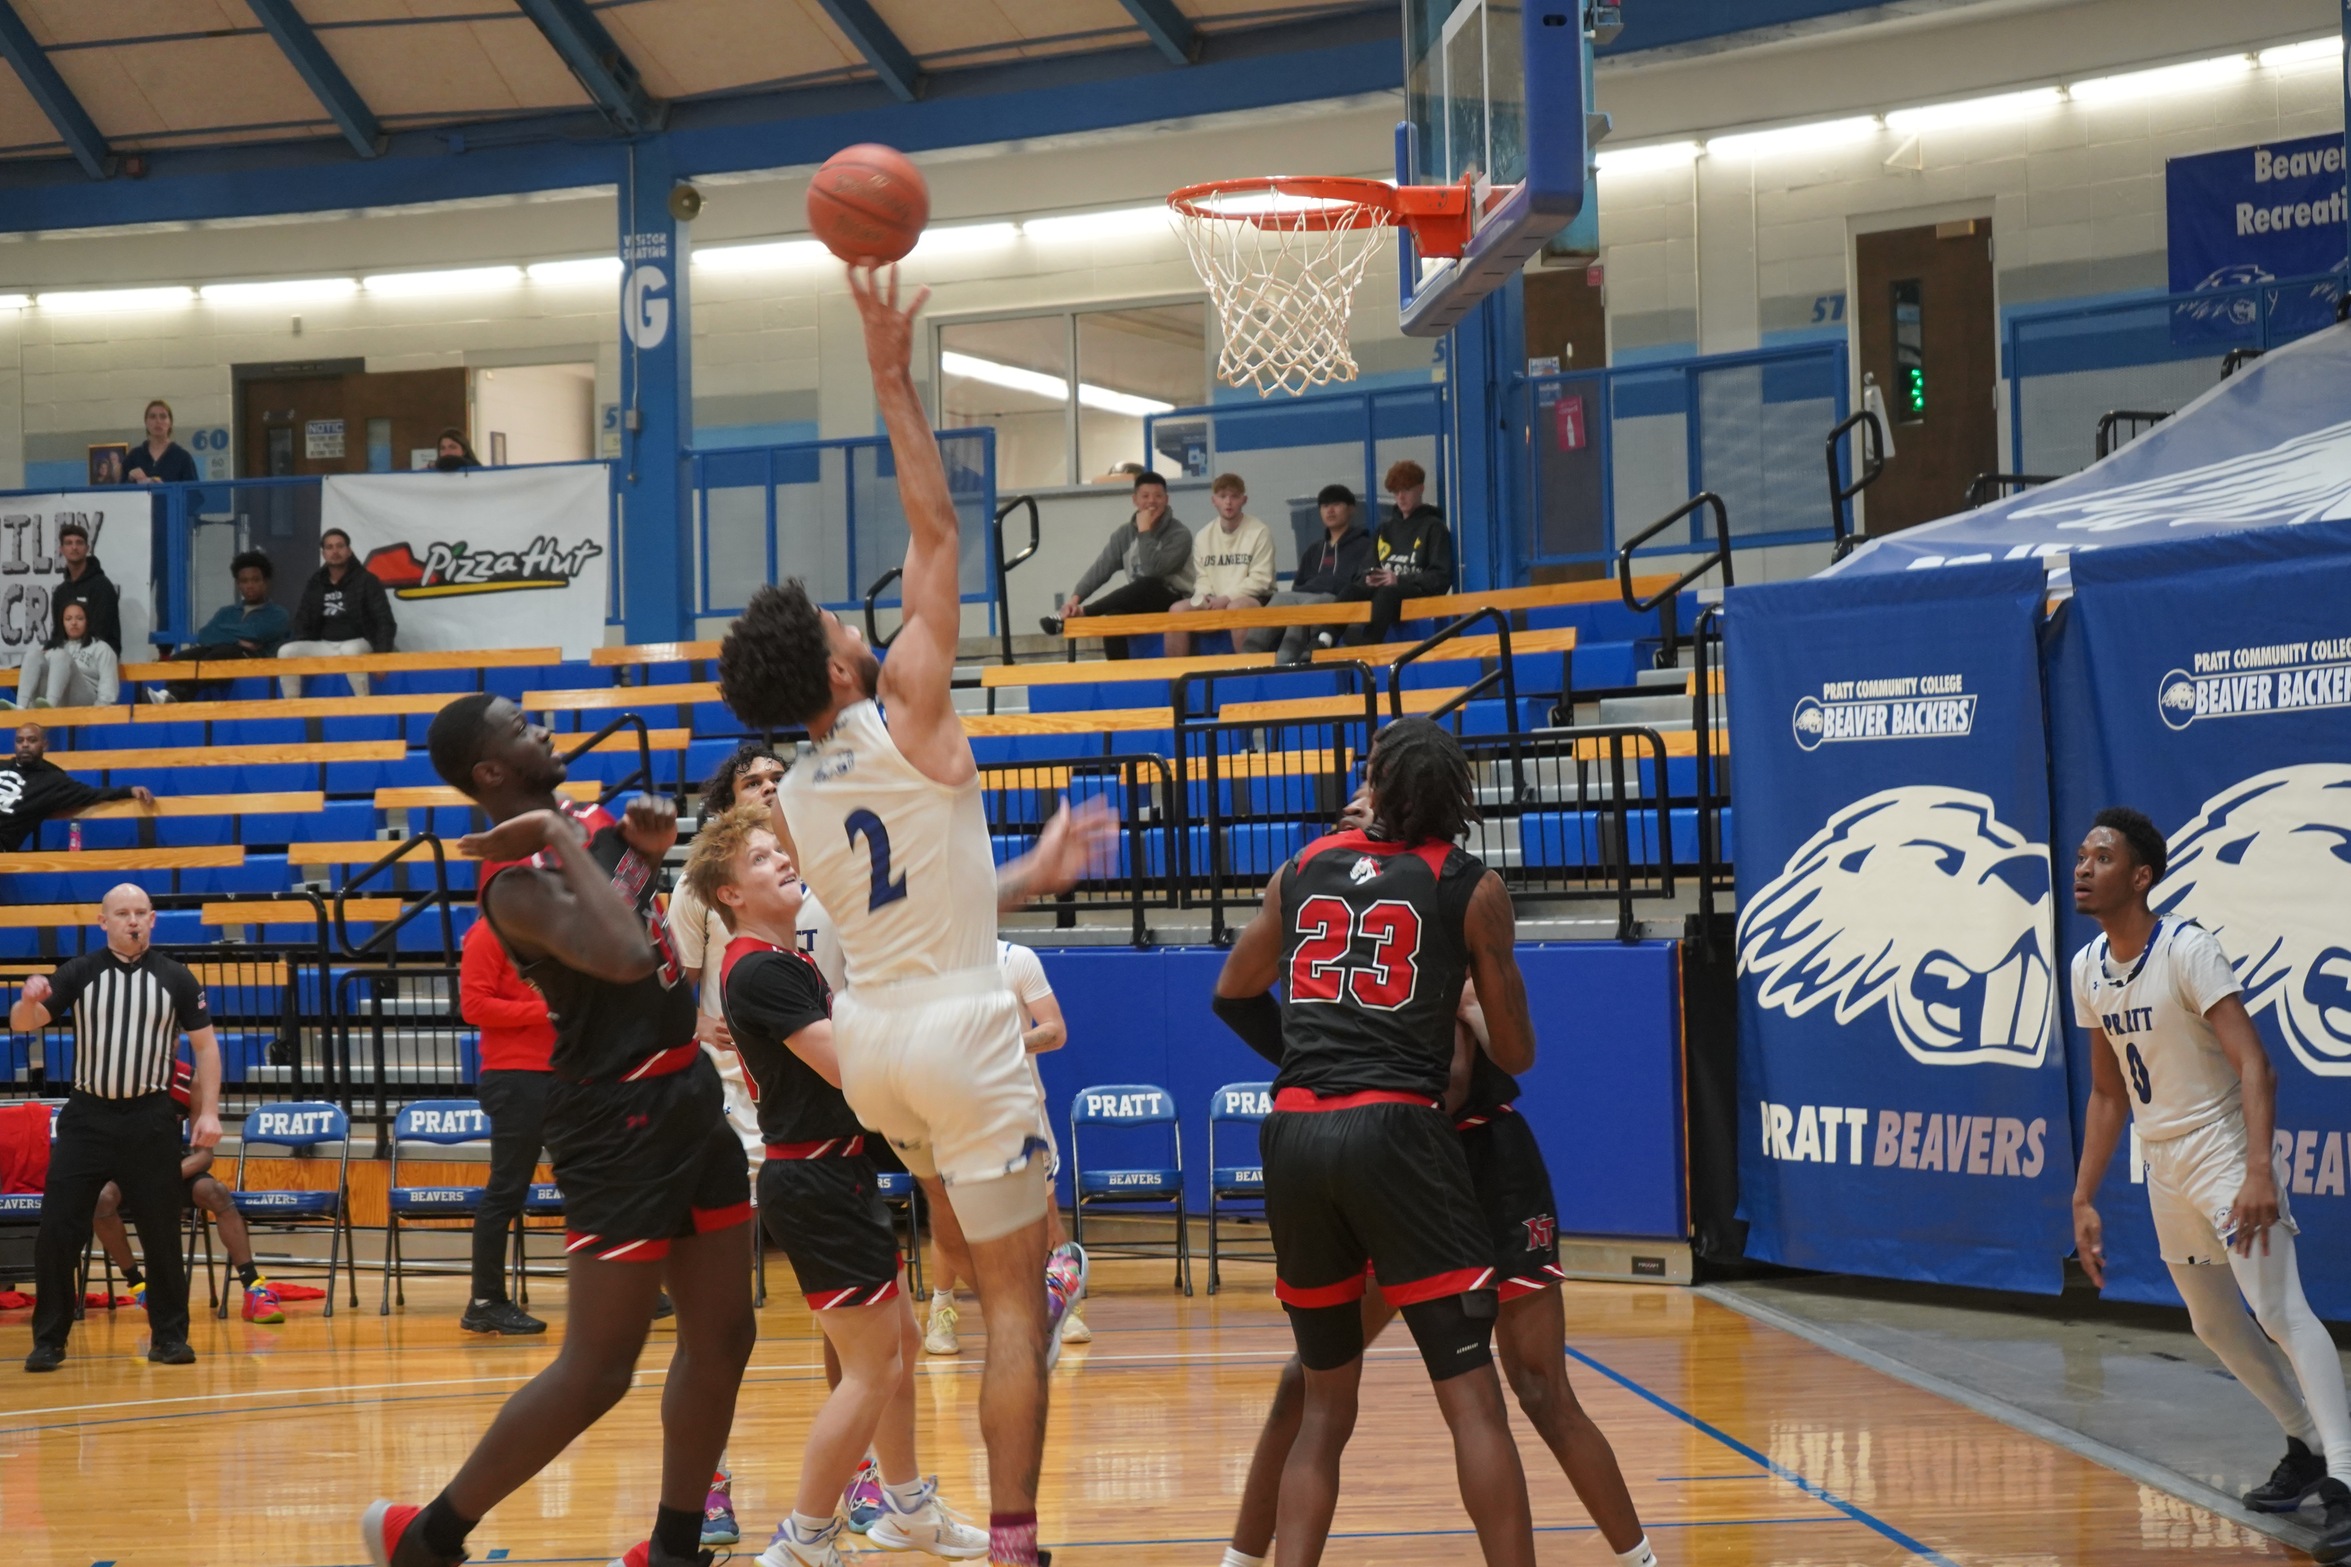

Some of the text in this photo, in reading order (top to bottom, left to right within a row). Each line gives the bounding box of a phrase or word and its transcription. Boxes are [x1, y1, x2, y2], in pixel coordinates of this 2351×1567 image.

[623, 233, 667, 247] VSITOR
[623, 264, 669, 350] G
[1811, 294, 1847, 323] 57
[192, 429, 229, 451] 60
[0, 511, 104, 575] ILEY
[420, 535, 603, 587] Pizza Hut
[2194, 650, 2231, 673] PRATT
[2233, 642, 2308, 669] COMMUNITY
[1823, 674, 1962, 700] PRATT COMMUNITY COLLEGE
[2195, 674, 2273, 715] BEAVER
[1823, 699, 1969, 738] BEAVER BACKERS
[844, 808, 908, 915] 2
[1290, 894, 1422, 1012] 23
[2126, 1042, 2151, 1104] 0
[1087, 1093, 1162, 1117] PRATT
[1225, 1092, 1272, 1114] PRA
[258, 1111, 334, 1135] PRATT
[410, 1109, 484, 1133] PRATT
[1760, 1100, 2047, 1178] PRATT BEAVERS
[1109, 1174, 1162, 1185] BEAVERS
[410, 1191, 464, 1202] BEAVERS
